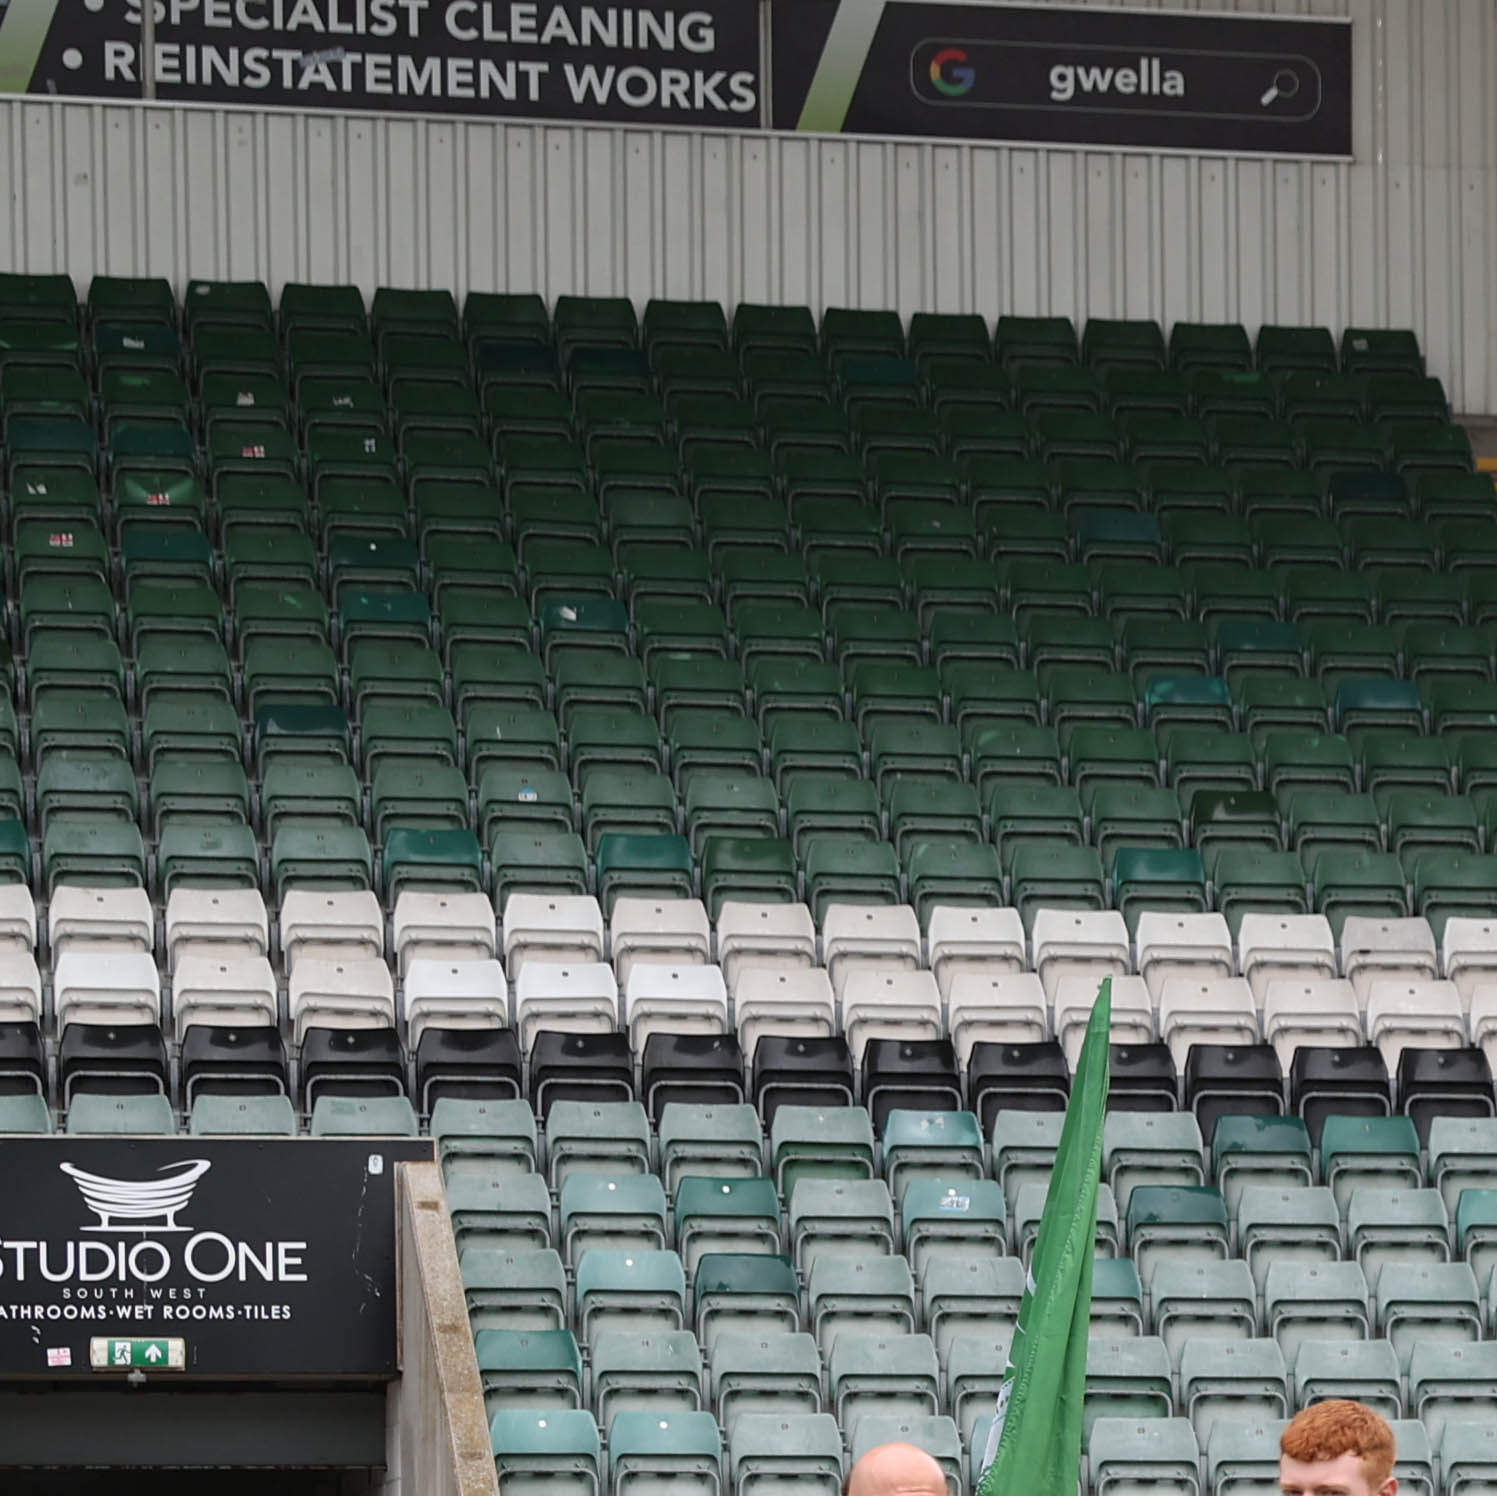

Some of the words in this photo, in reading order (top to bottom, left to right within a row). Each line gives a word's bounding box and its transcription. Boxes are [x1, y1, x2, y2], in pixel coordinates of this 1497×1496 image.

[445, 0, 715, 53] CLEANING
[104, 40, 549, 102] REINSTATEMENT
[563, 61, 757, 112] WORKS
[1050, 57, 1186, 103] gwella
[0, 1237, 171, 1282] TUDIO
[184, 1231, 308, 1283] ONE
[62, 1287, 135, 1299] SOUTH
[149, 1287, 206, 1299] WEST
